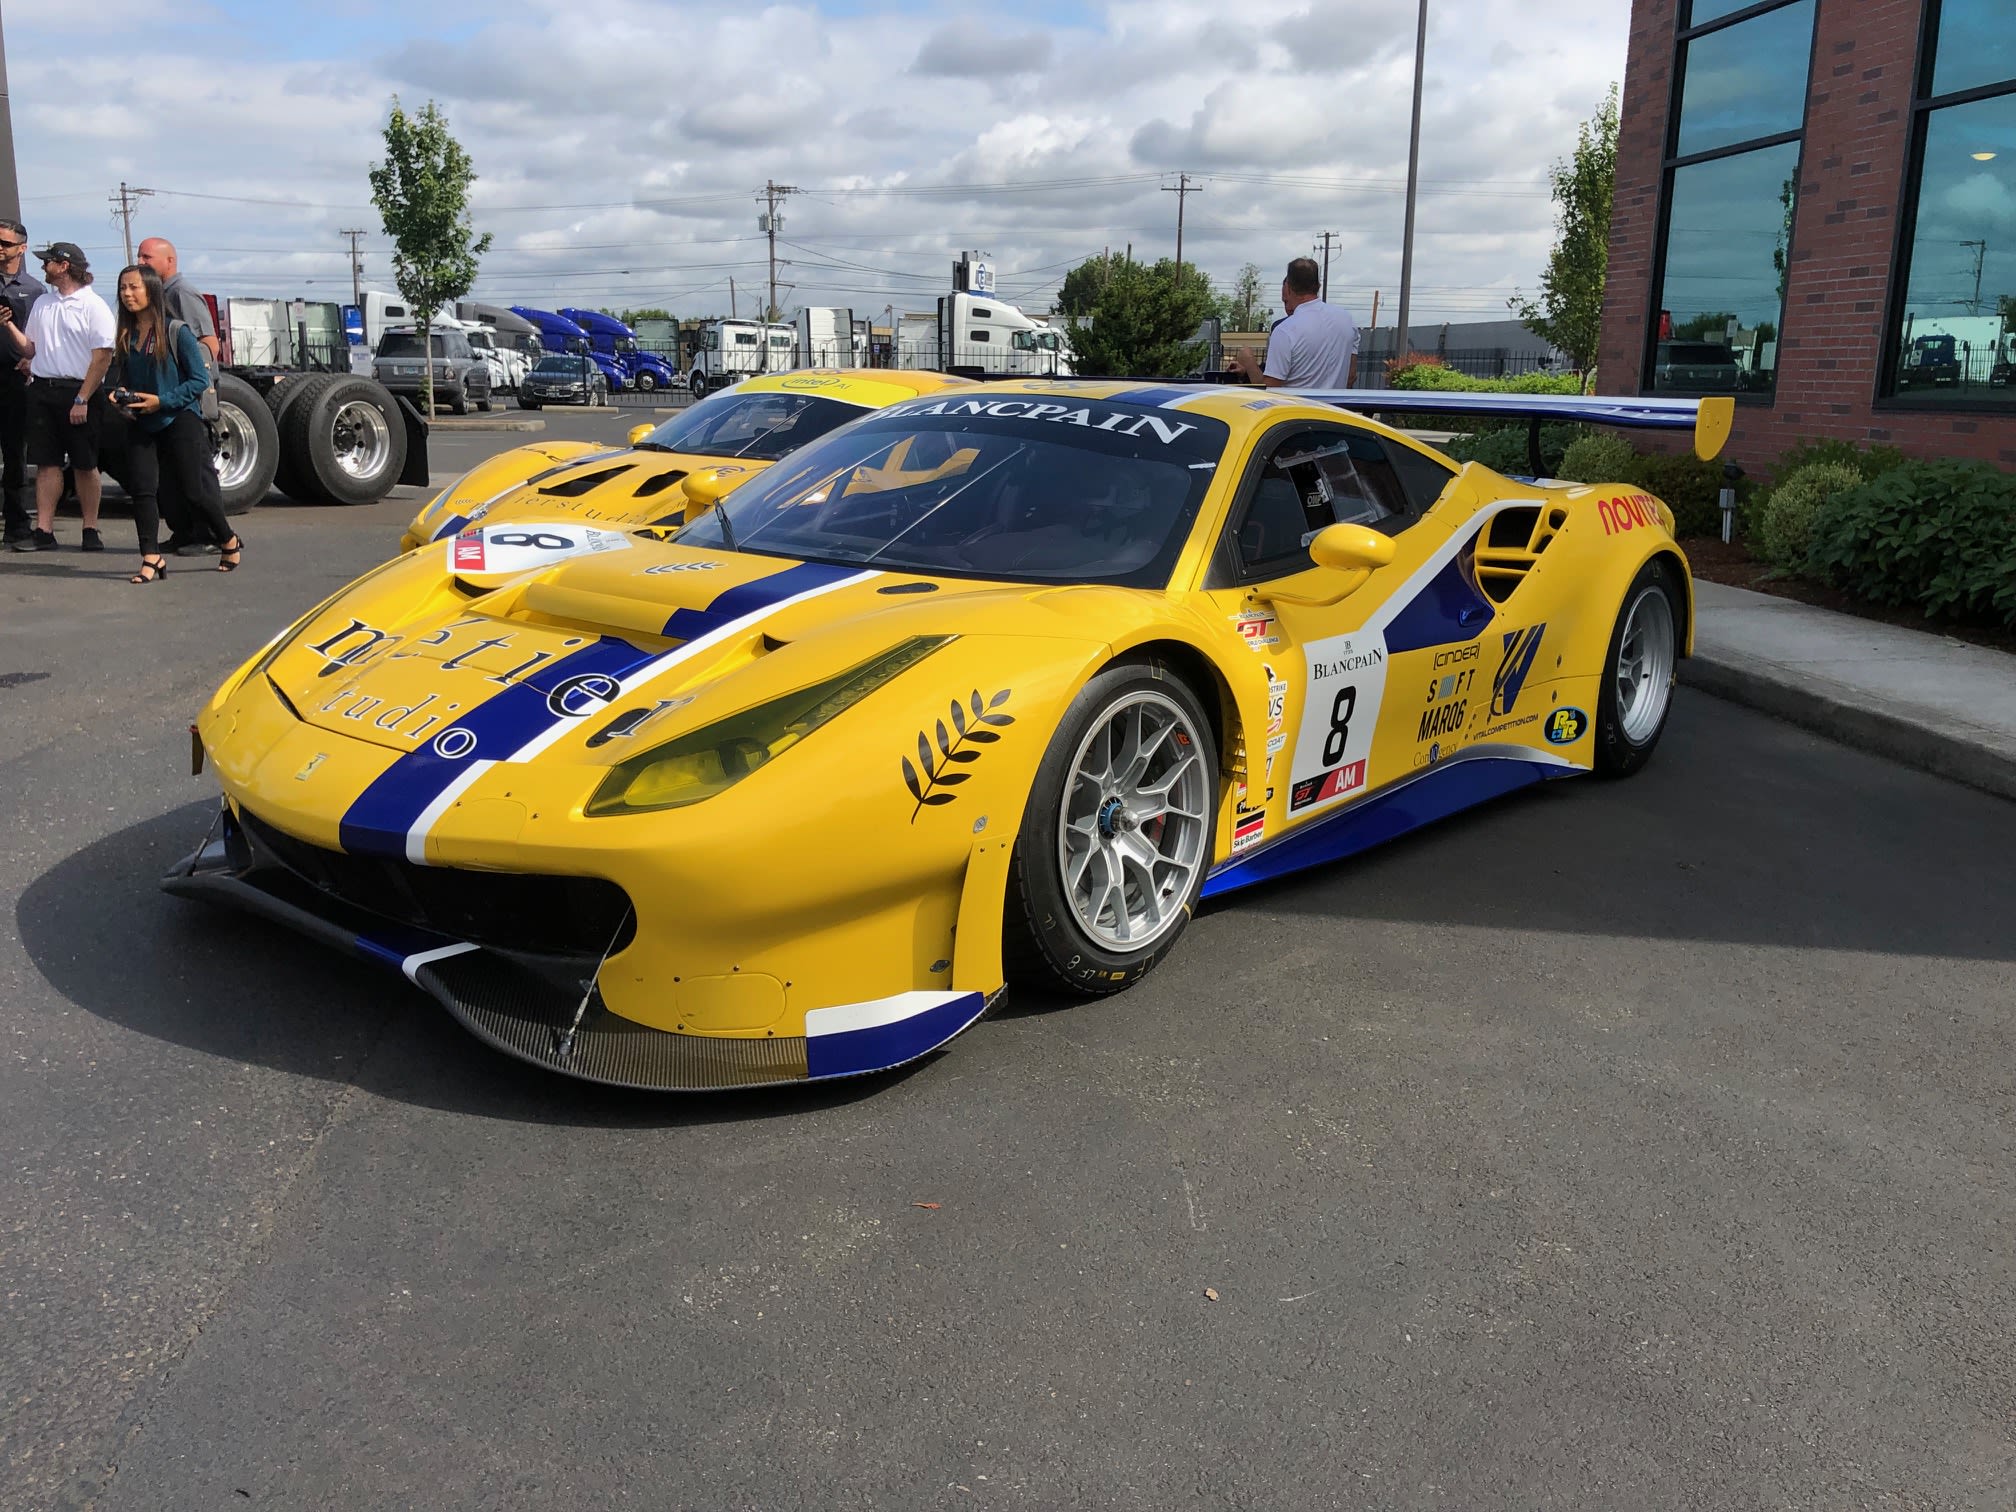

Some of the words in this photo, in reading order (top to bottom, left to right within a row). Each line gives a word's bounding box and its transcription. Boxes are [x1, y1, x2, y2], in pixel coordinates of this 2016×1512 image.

[864, 400, 1198, 444] BLANCPAIN
[489, 532, 575, 550] 8
[1313, 648, 1382, 680] BLANCPAIN
[320, 684, 478, 760] tudio
[1322, 685, 1357, 768] 8
[1335, 764, 1357, 793] AM
